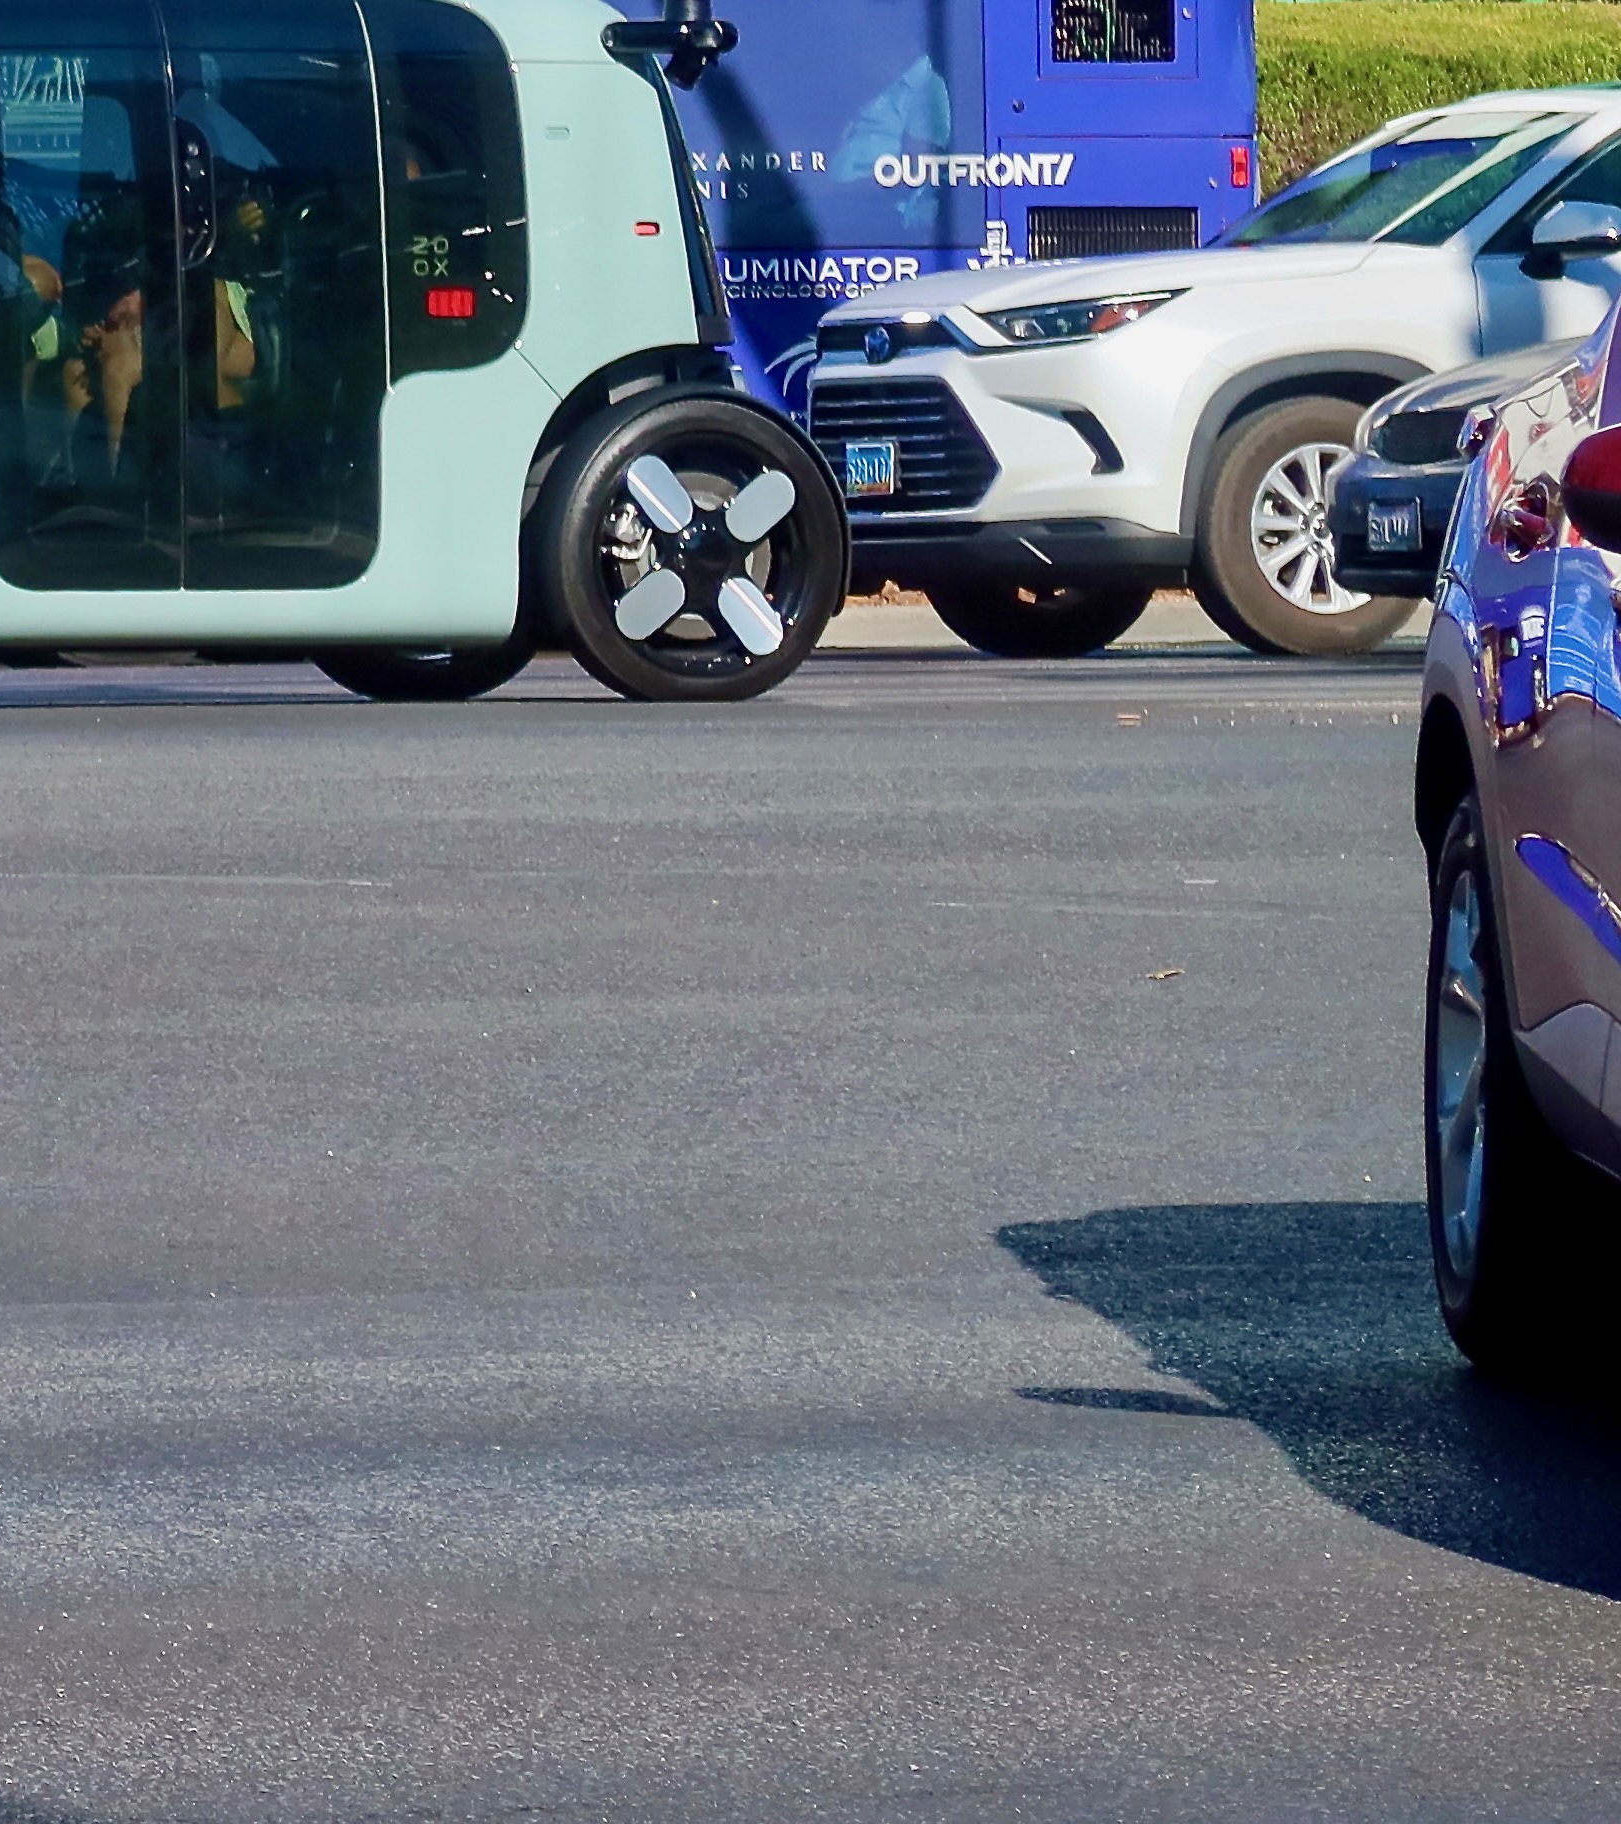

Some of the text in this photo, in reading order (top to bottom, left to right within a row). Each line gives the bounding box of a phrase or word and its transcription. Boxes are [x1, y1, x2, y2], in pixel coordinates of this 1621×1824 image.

[691, 151, 826, 172] XANDER
[696, 180, 748, 200] NIS
[724, 257, 920, 283] UMINATOR
[723, 283, 841, 299] CHNOLOGY
